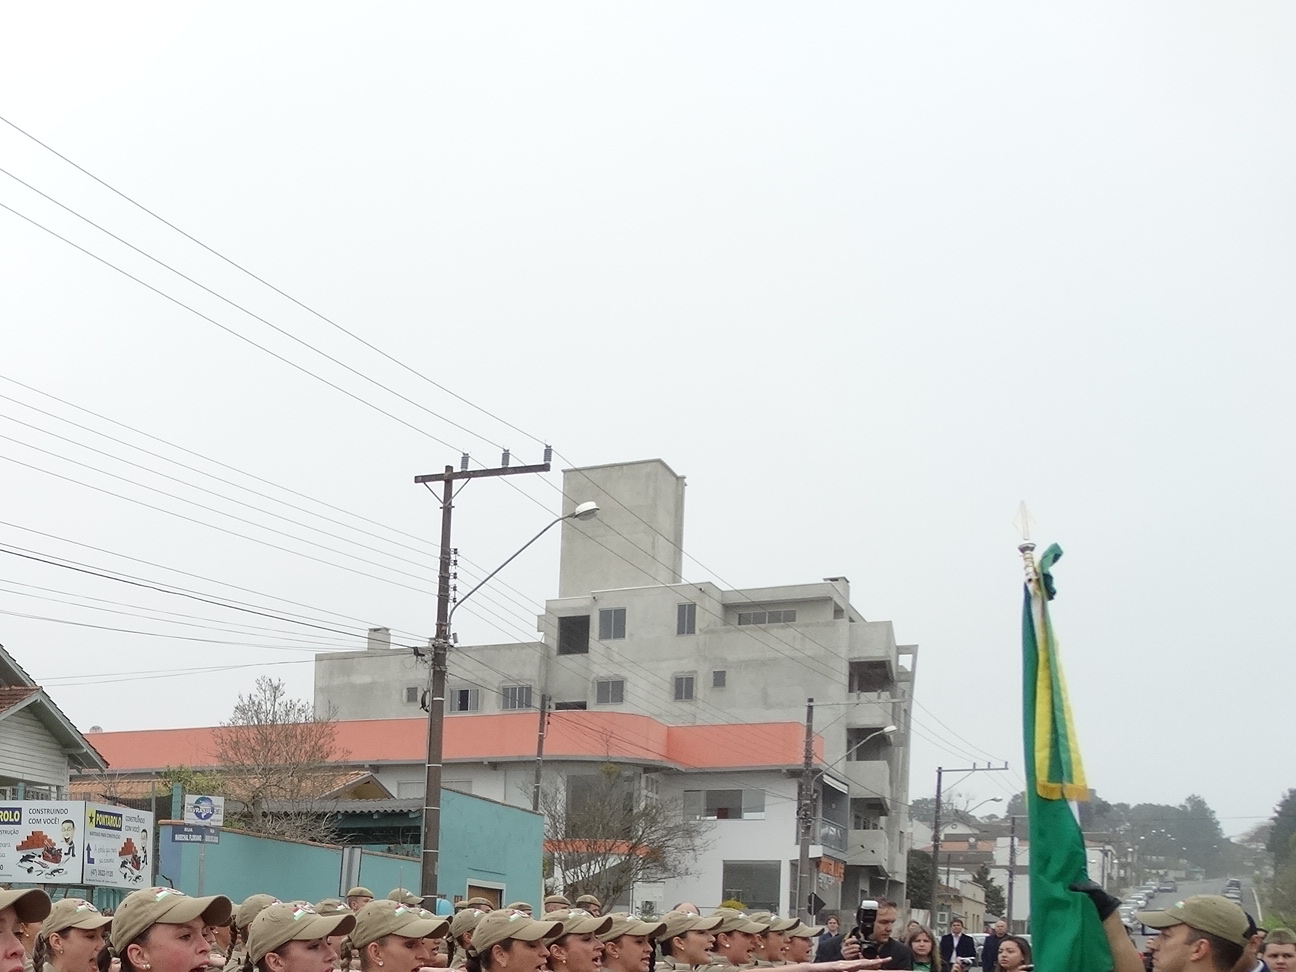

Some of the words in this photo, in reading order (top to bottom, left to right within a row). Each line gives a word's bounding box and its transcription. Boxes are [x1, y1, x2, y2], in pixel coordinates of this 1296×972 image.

[43, 817, 60, 825] VOCÊ!
[96, 813, 122, 828] PONTAROLO
[0, 842, 11, 850] para
